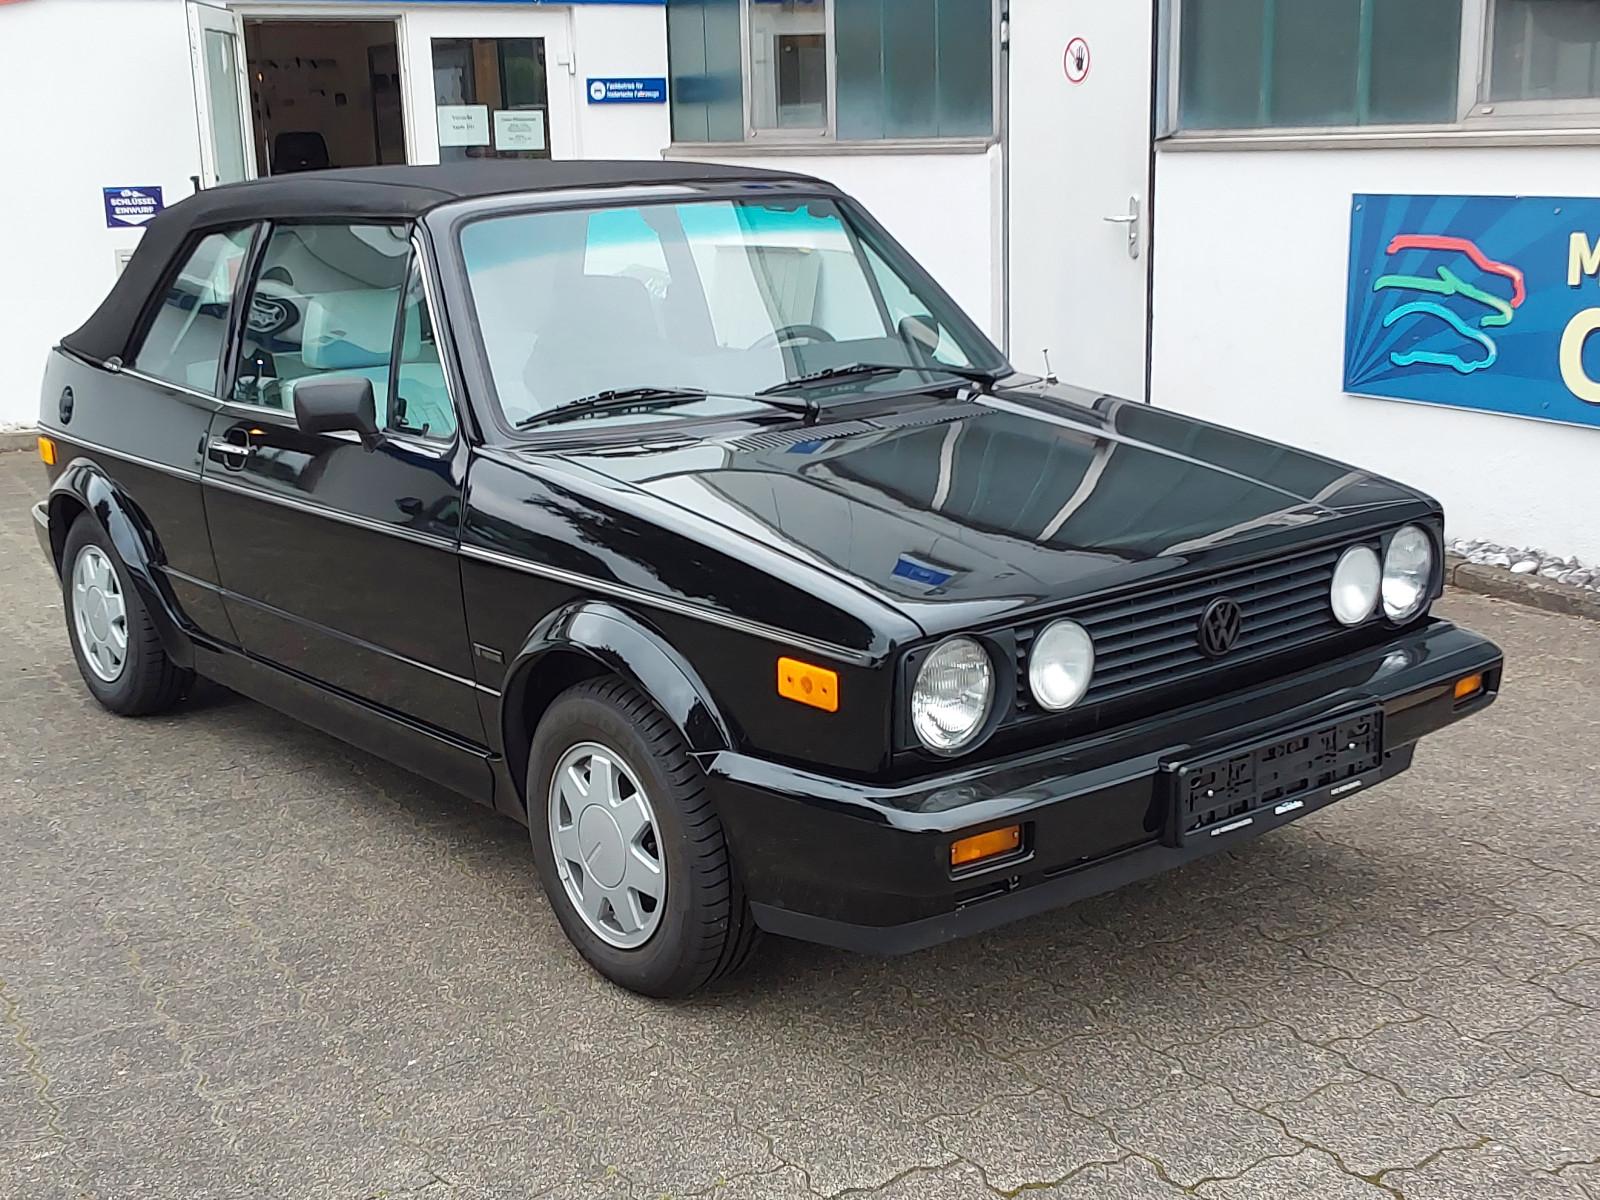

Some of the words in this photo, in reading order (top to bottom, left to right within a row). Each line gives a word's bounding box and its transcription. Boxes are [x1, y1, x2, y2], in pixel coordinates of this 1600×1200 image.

[110, 197, 157, 206] SCHLÜSSEL
[114, 206, 155, 214] EINWURF
[1200, 597, 1240, 656] VW
